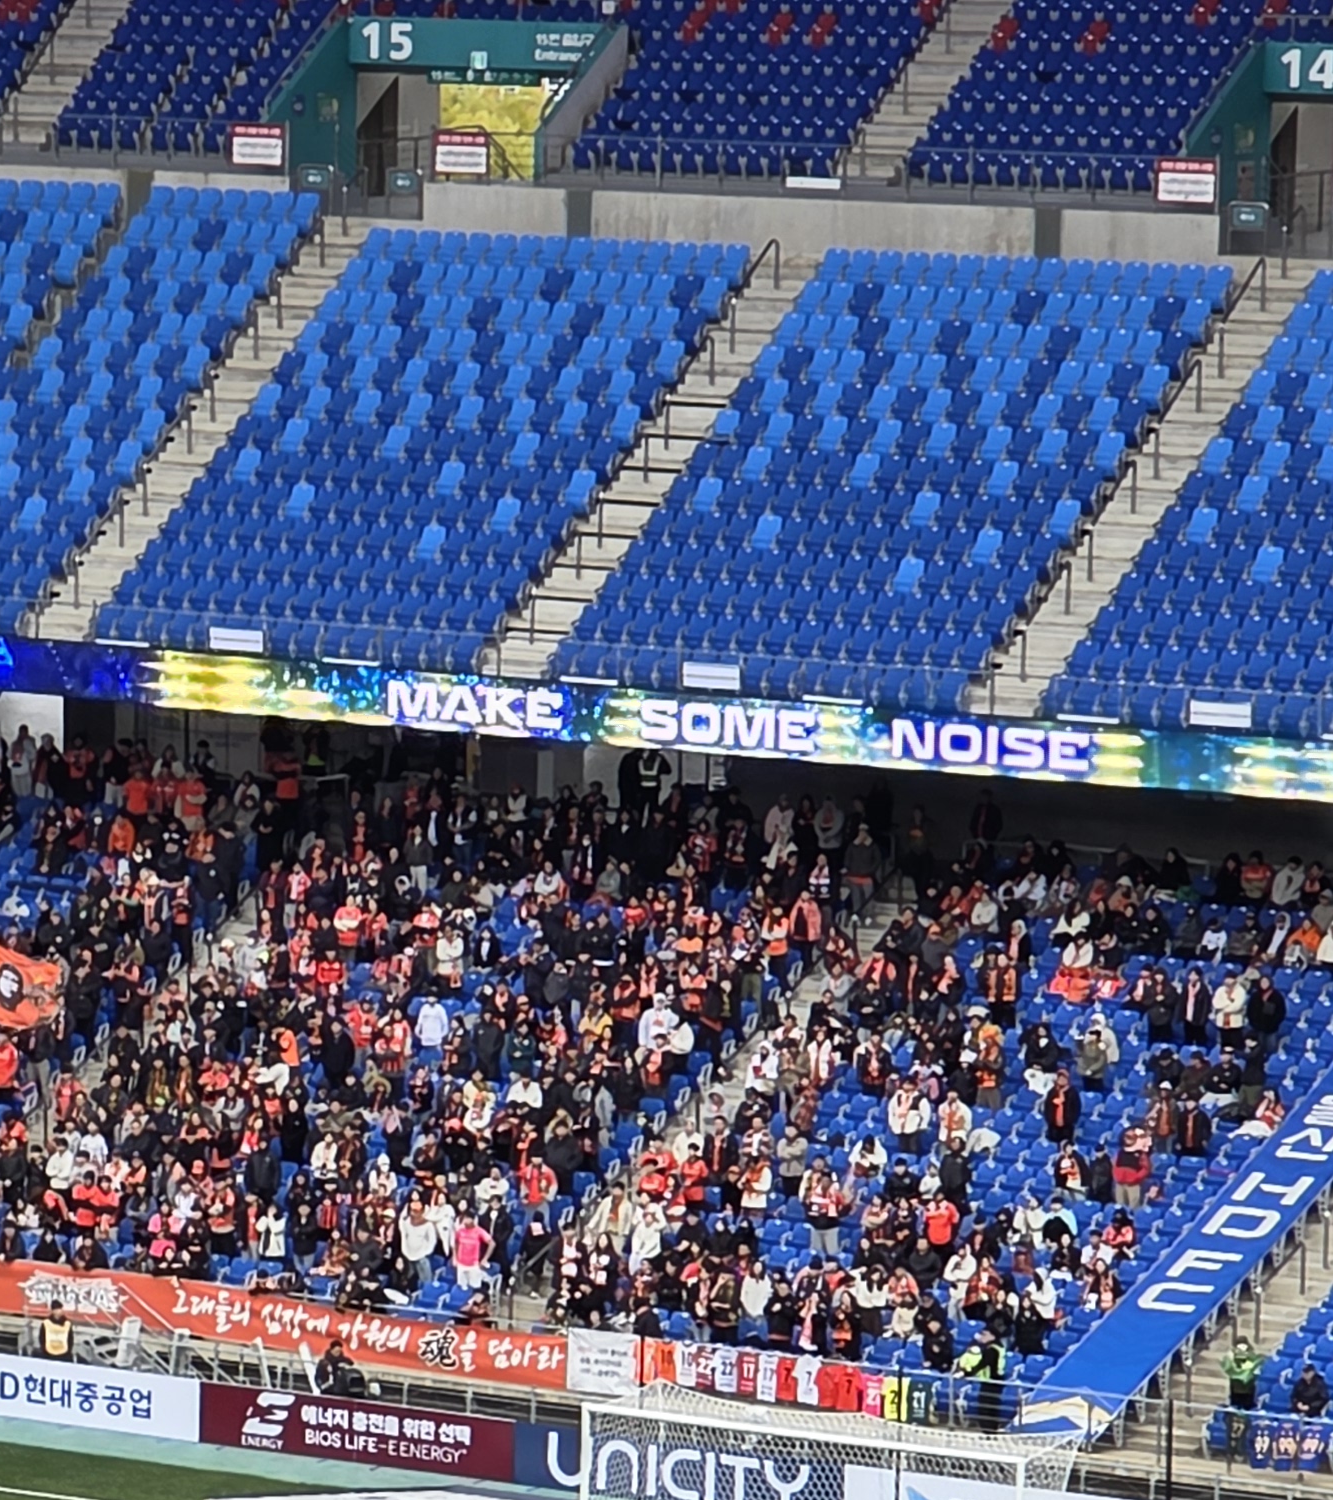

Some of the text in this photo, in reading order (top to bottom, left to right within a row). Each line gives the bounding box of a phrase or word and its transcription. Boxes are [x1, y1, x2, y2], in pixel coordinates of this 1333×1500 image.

[361, 22, 413, 61] 15
[534, 48, 583, 62] Entranc
[1281, 49, 1333, 90] 14
[387, 680, 1091, 772] MAKE SOME NOISE
[171, 1288, 251, 1334] 그대들의
[338, 1313, 411, 1351] 강원의
[487, 1337, 566, 1371] 담아라
[300, 1404, 349, 1430] 에너지
[241, 1434, 284, 1451] ENERGY
[305, 1428, 342, 1449] BIOS
[399, 1441, 463, 1464] ENERGY
